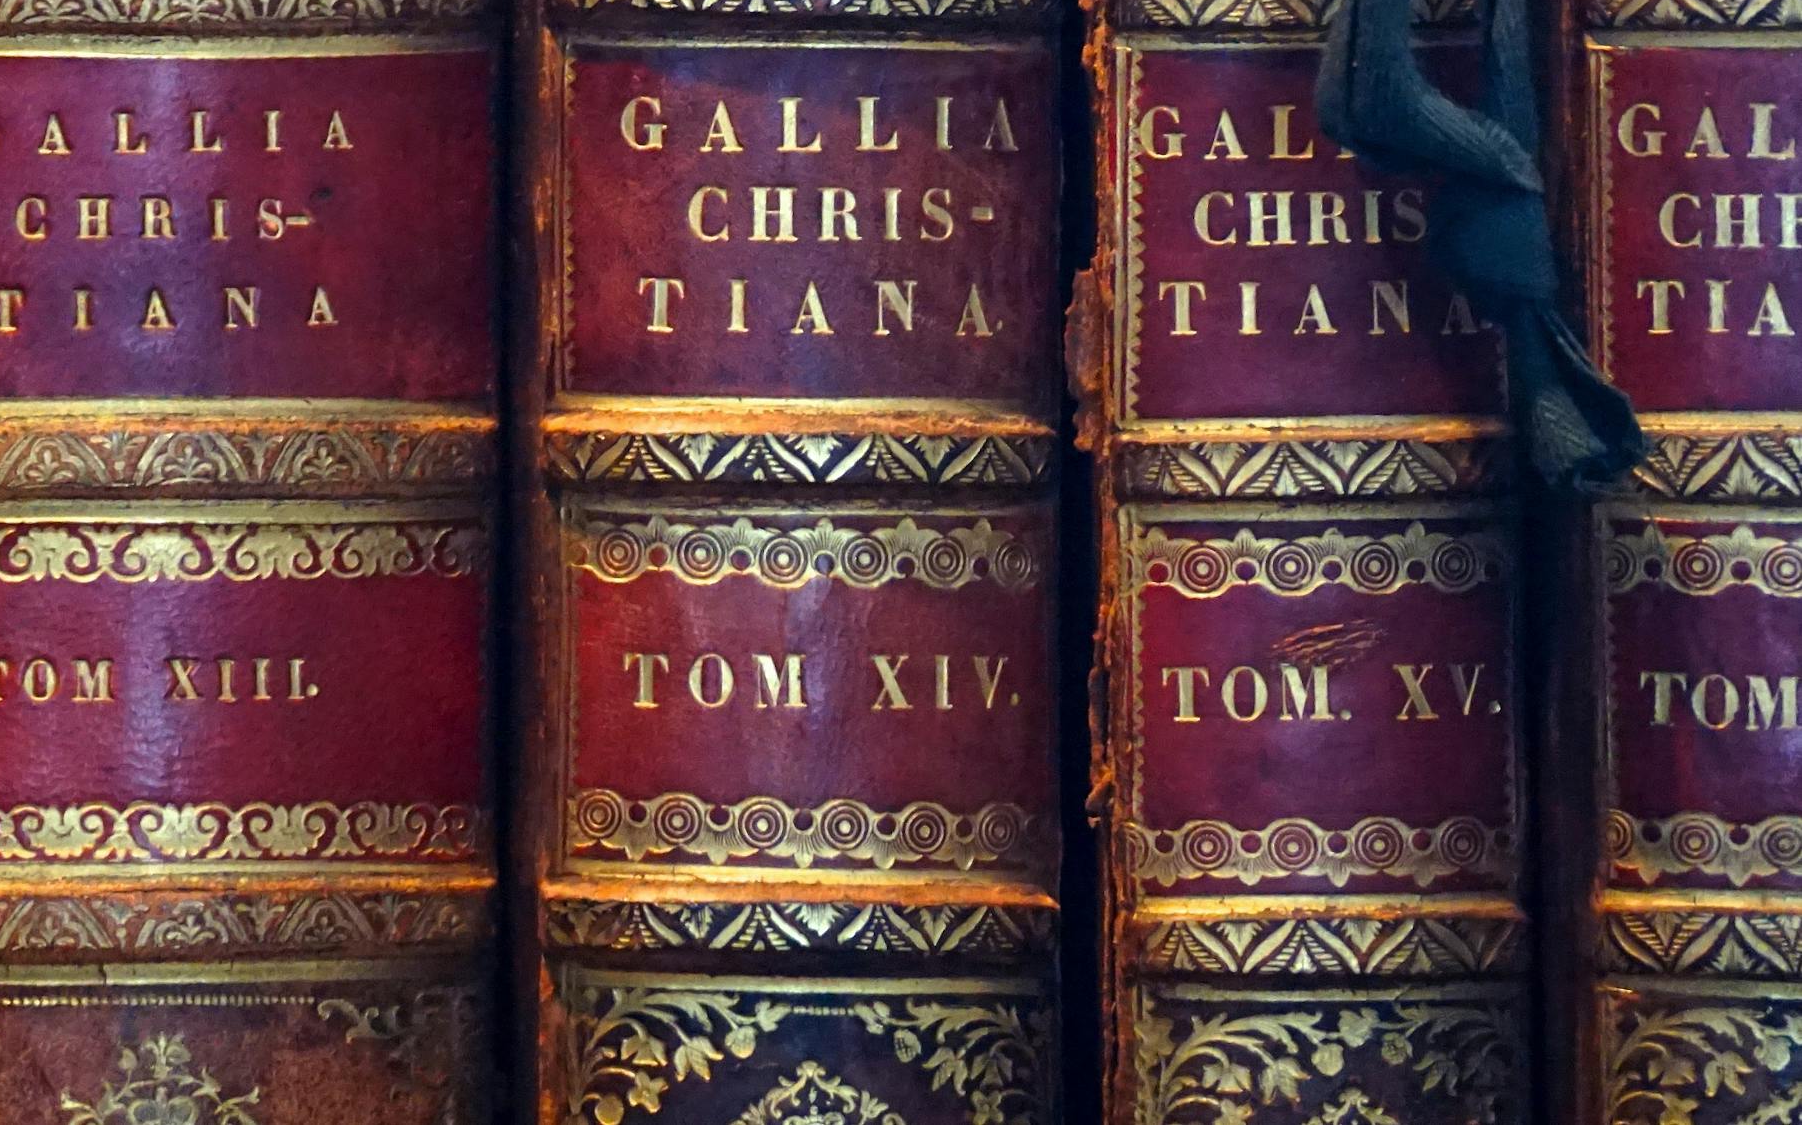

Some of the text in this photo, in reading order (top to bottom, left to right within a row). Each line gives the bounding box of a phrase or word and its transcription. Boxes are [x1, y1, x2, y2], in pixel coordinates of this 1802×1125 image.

[620, 95, 1020, 153] GALLIA
[1137, 104, 1357, 161] GAL
[1617, 103, 1796, 160] GAL
[14, 197, 312, 241] CHRIS-
[687, 186, 995, 243] CHRIS-
[1193, 188, 1430, 247] CHRIS
[1636, 279, 1796, 337] TIA
[166, 658, 319, 702] XIII.
[623, 653, 1020, 710] TOM XIV.
[1162, 663, 1502, 722] TOM. XV.
[1640, 671, 1802, 731] TOM
